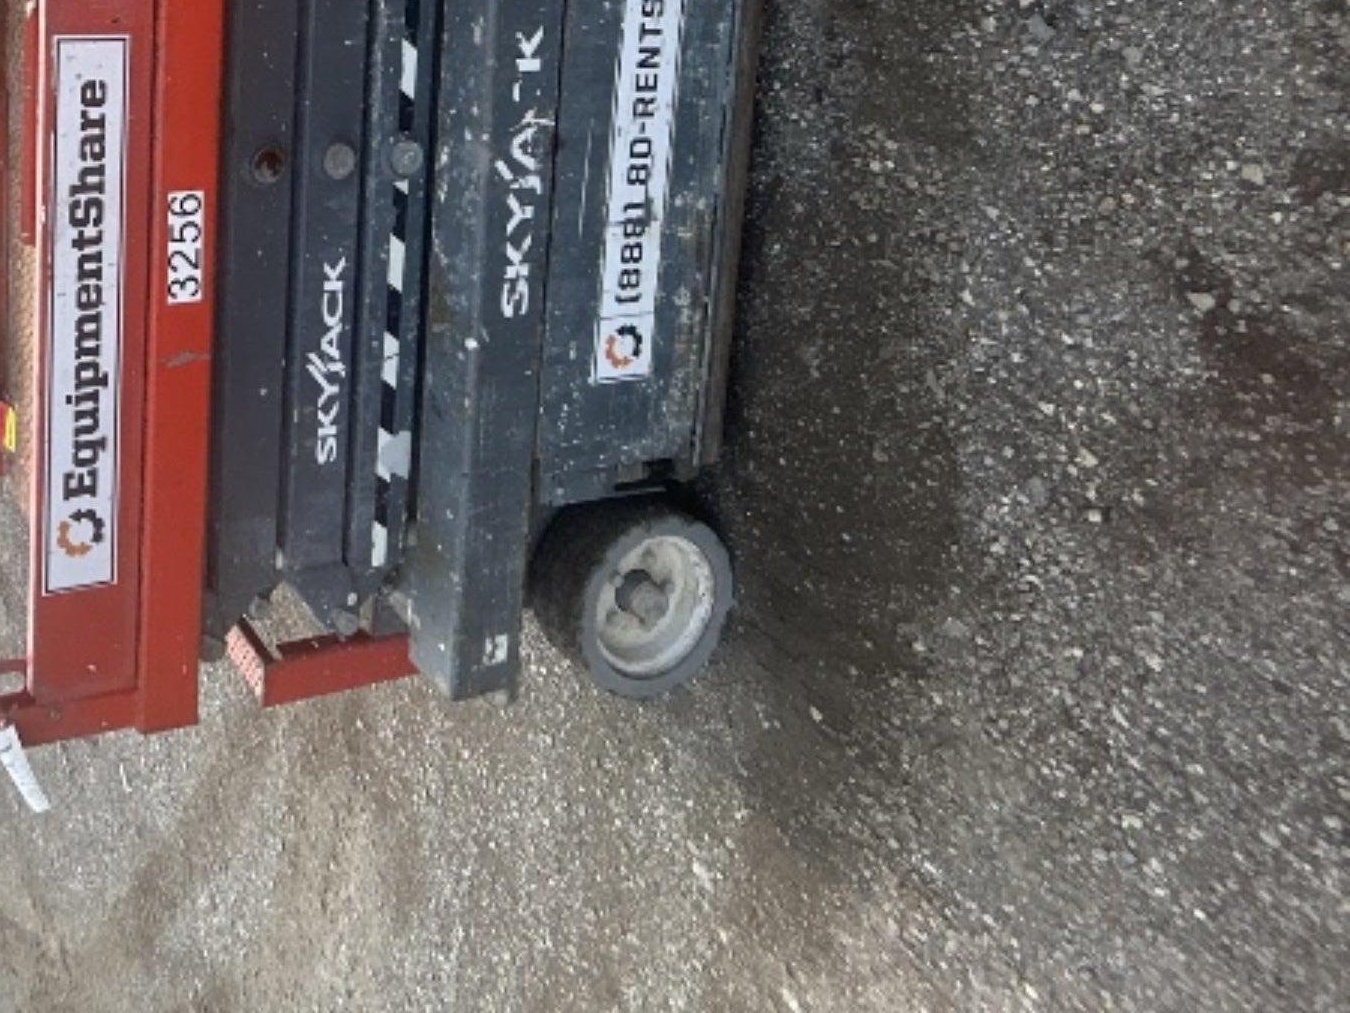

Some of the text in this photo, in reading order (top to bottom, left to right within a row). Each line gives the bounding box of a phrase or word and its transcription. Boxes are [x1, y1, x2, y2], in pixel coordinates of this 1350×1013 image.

[62, 78, 109, 502] EquipmentShare
[167, 192, 202, 301] 3256
[305, 256, 347, 465] SKYJACK
